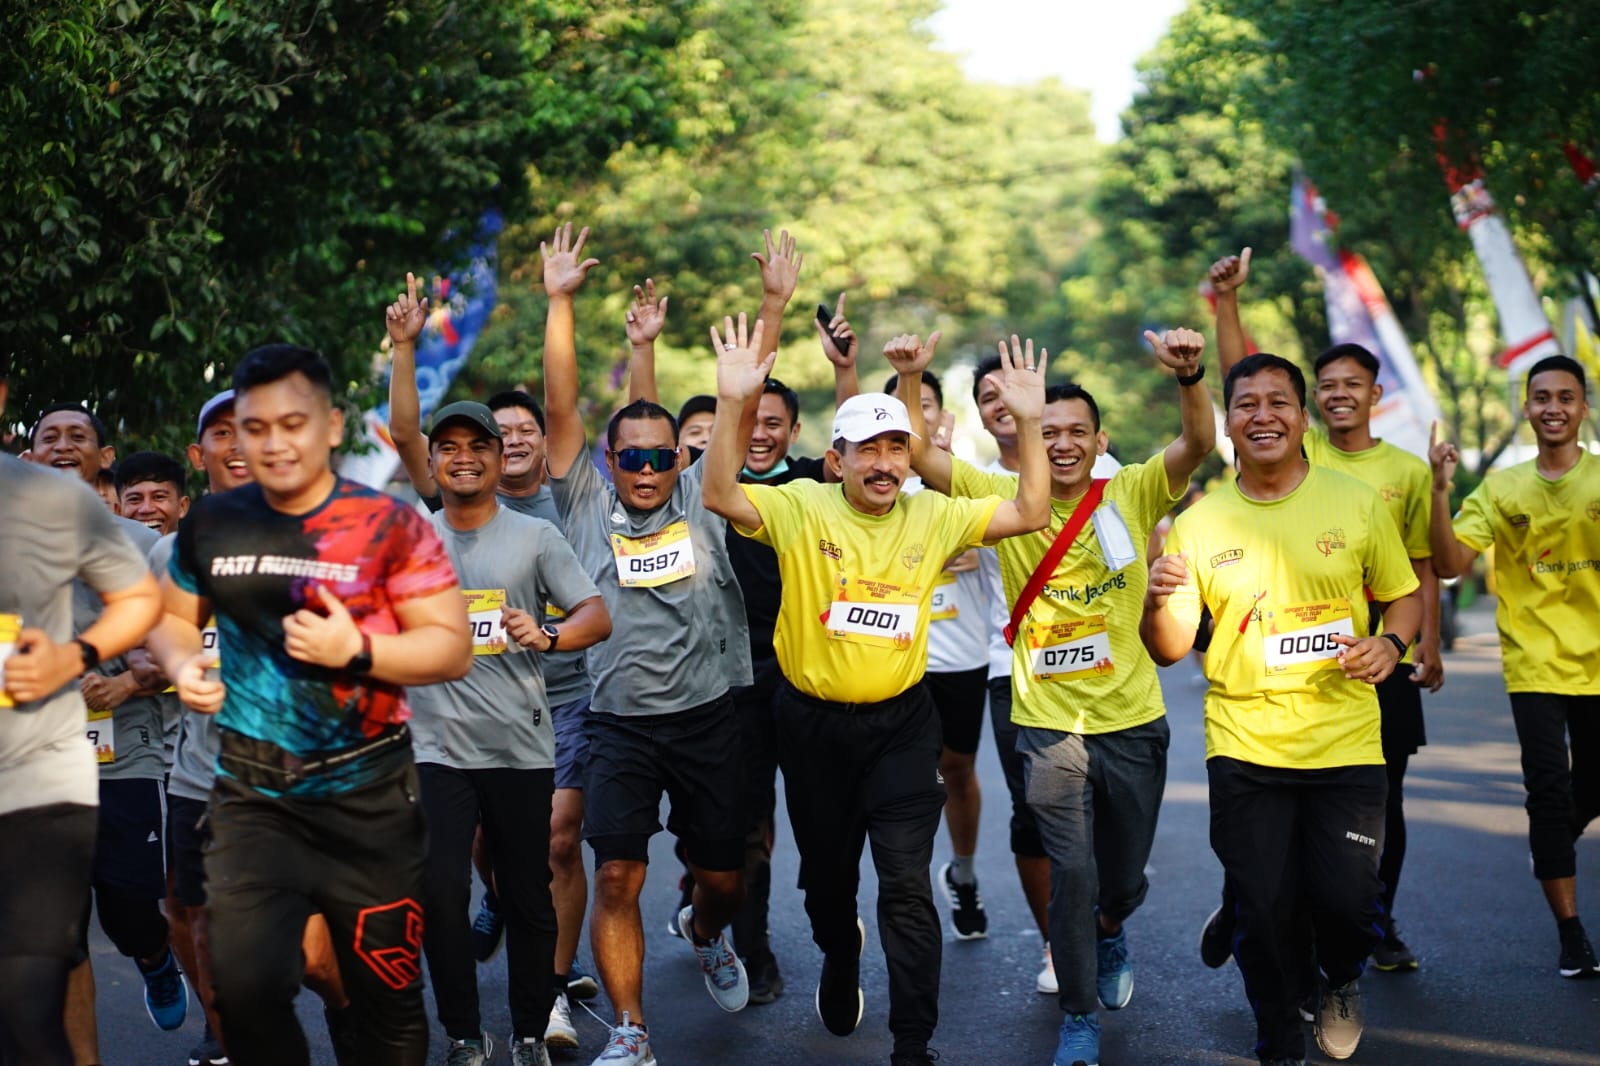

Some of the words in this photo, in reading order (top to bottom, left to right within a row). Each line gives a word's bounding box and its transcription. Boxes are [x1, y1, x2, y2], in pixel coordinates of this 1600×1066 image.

[211, 555, 256, 576] PATI
[257, 555, 359, 583] RUNNERS
[630, 551, 679, 572] 0597
[1536, 561, 1565, 573] Bank
[847, 607, 900, 630] 0001
[1280, 632, 1340, 655] 0005
[1045, 645, 1094, 666] 0775
